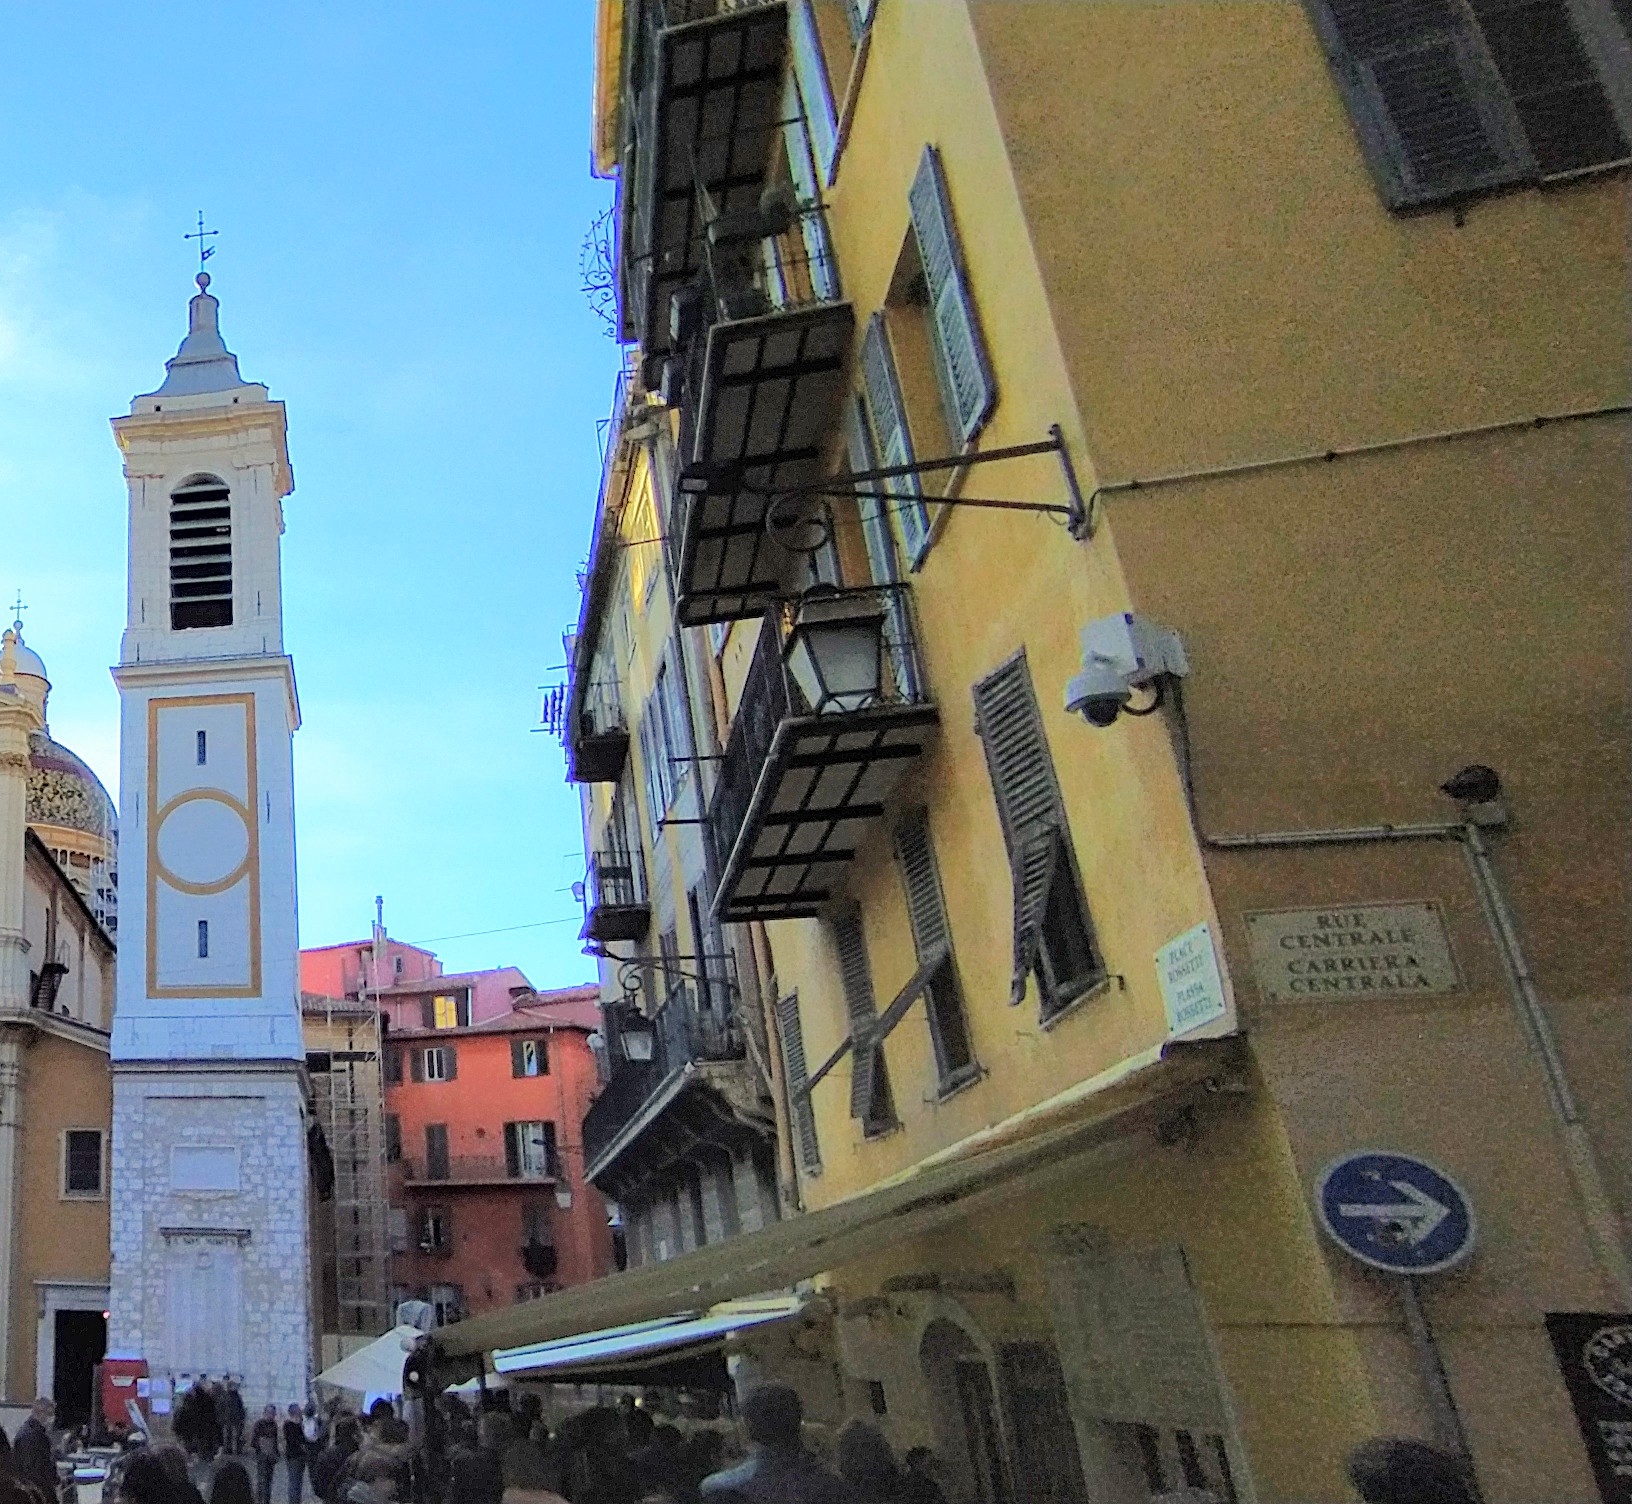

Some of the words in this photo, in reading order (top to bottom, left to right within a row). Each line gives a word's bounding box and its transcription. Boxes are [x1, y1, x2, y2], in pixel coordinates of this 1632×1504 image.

[1316, 912, 1368, 930] RUE
[1279, 928, 1416, 951] CENTRALE
[1286, 954, 1421, 975] CARRIERA
[1288, 973, 1433, 993] CENTRALA
